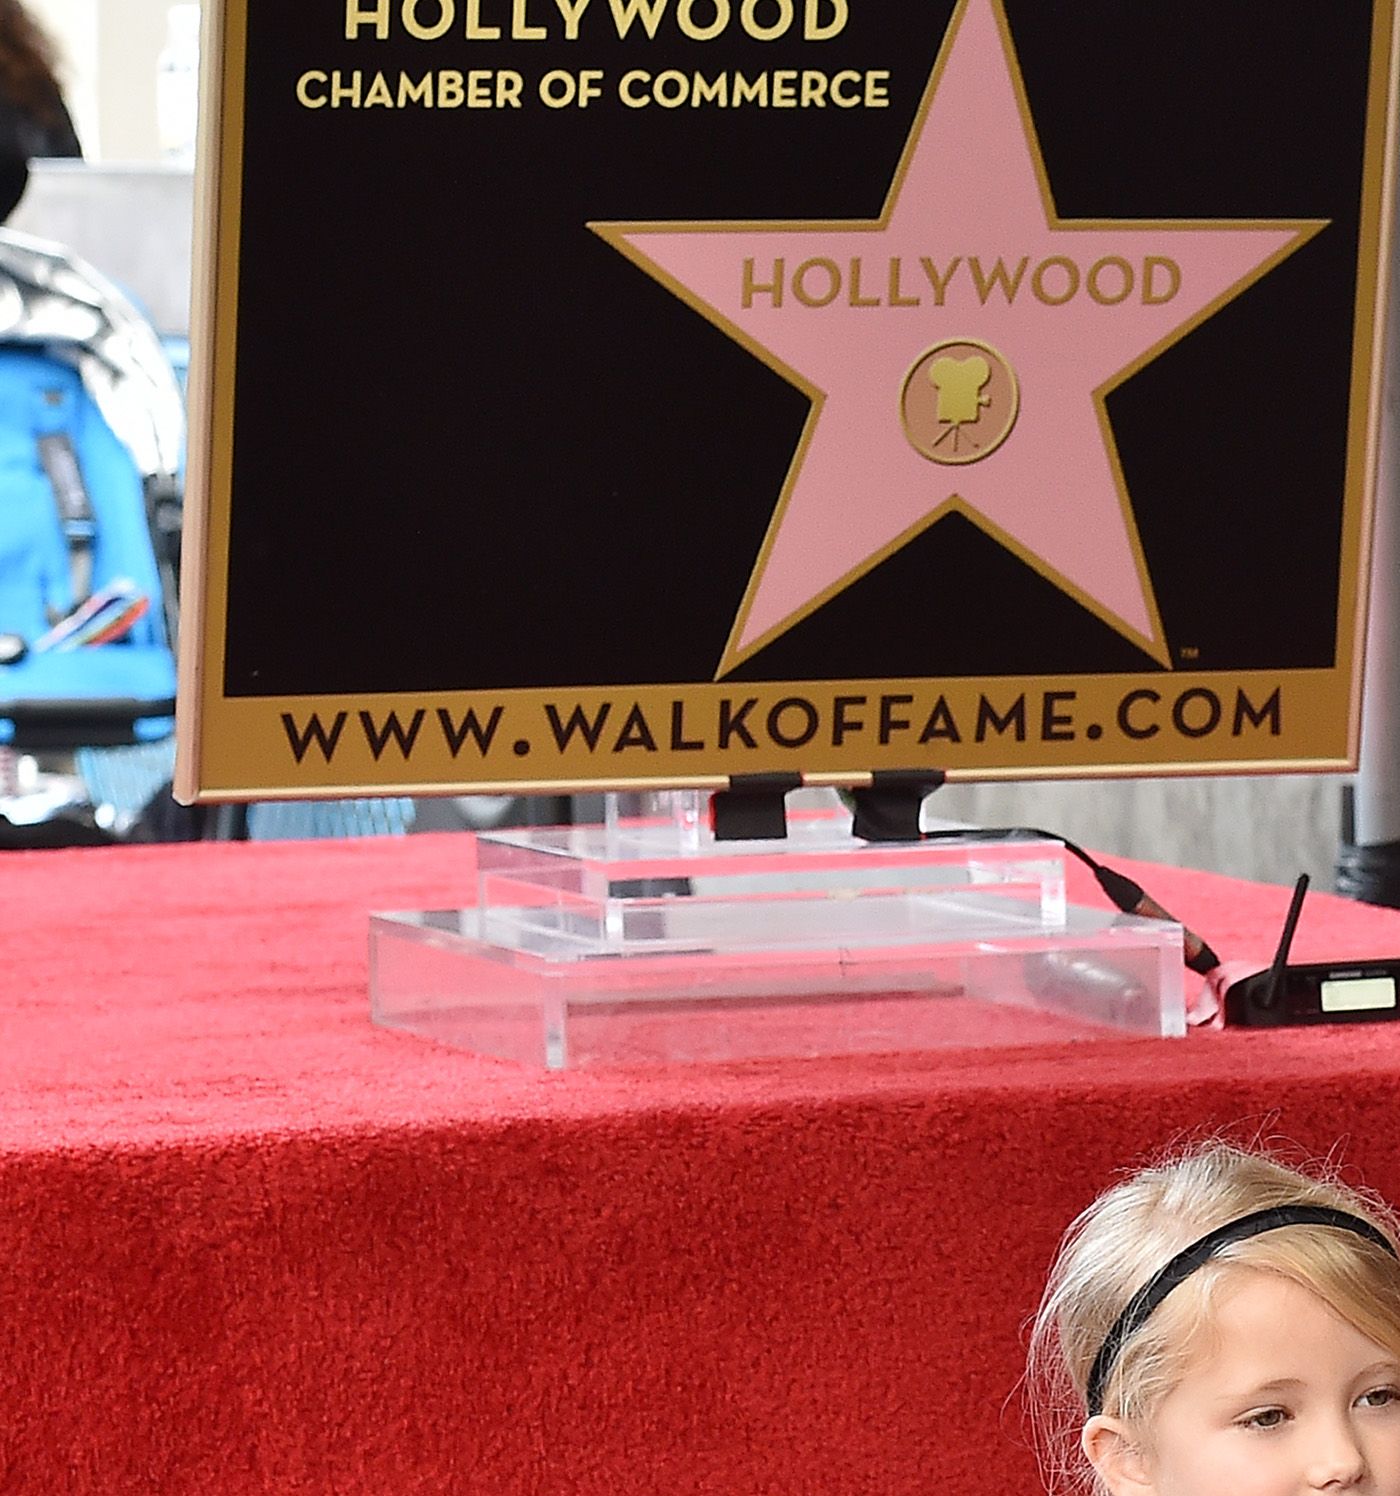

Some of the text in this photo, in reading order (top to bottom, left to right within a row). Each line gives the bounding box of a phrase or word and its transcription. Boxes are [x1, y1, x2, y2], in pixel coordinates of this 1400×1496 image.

[343, 0, 850, 41] HOLLYWOOD
[296, 69, 891, 109] CHAMBER OF COMMERCE
[741, 255, 1181, 309] HOLLYWOOD
[282, 688, 1281, 764] WWW.WALKOFFAME.COM
